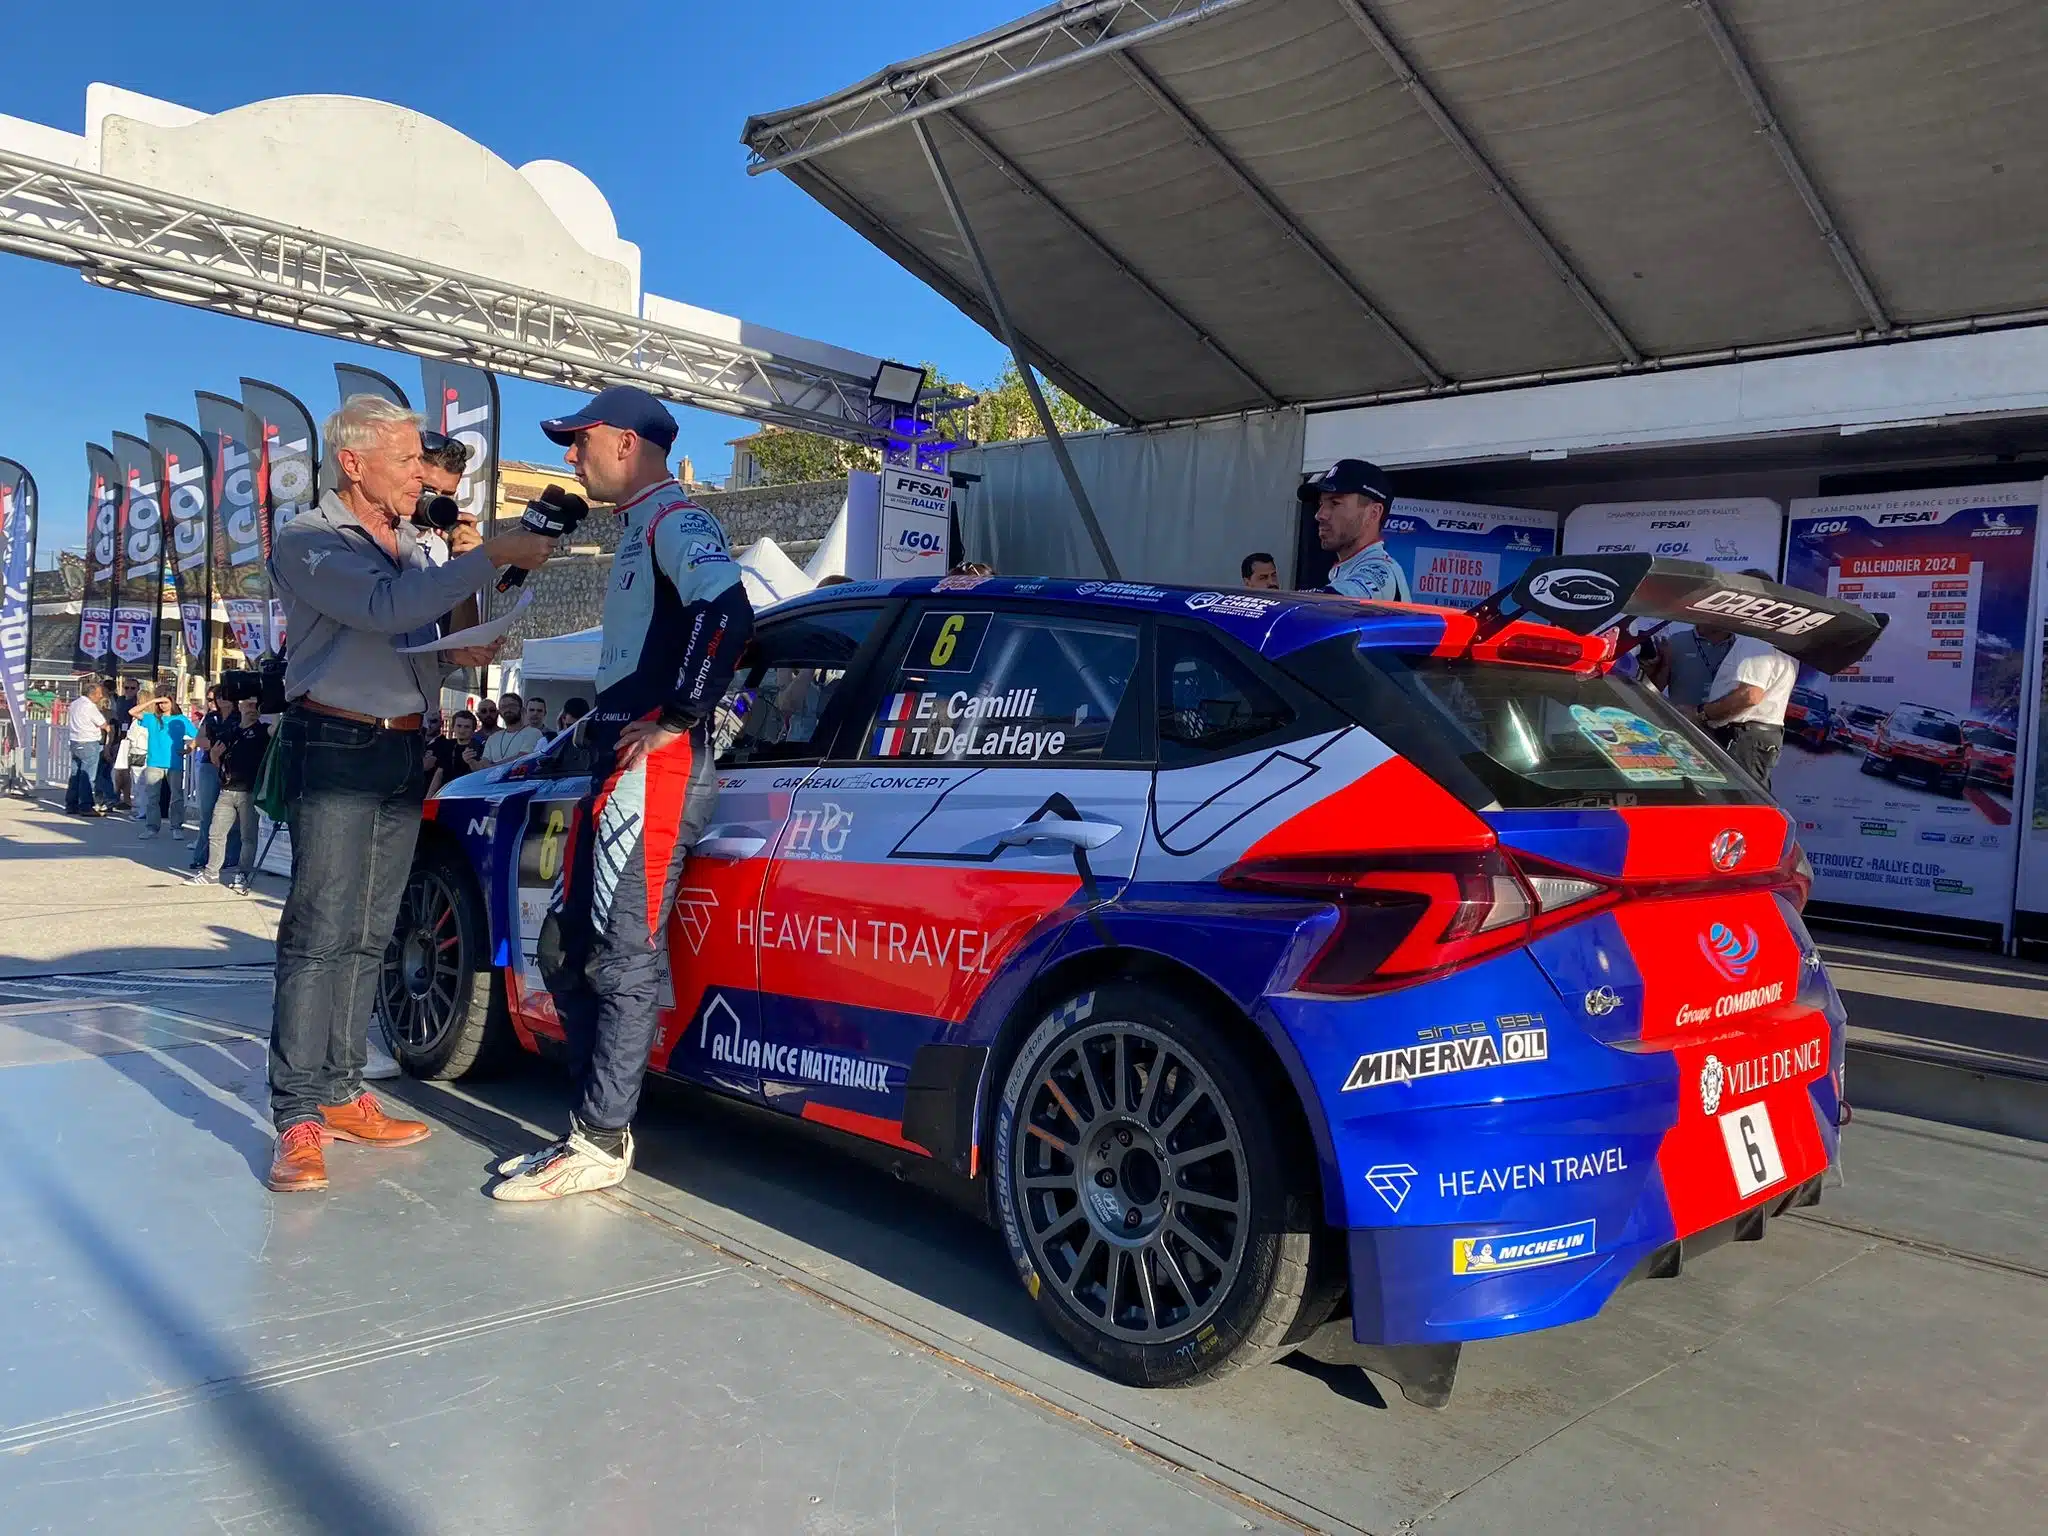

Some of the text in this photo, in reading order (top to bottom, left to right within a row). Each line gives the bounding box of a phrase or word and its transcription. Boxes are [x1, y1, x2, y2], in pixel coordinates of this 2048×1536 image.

[911, 498, 945, 512] RALLYE
[1810, 503, 1881, 514] CHAMPIONNAT
[1903, 500, 1943, 509] FRANCE
[1948, 497, 1968, 505] DES
[1971, 528, 2024, 537] MICHELIN
[1432, 557, 1483, 576] ANTIBES
[1854, 558, 1956, 574] CALENDRIER 2024
[1420, 573, 1492, 597] CÔTE D'AZUR
[929, 614, 965, 667] 6
[915, 688, 1037, 719] E. Camilli
[910, 727, 1066, 760] T. DeLaHaye
[772, 777, 950, 789] CARREAU CONCEPT
[540, 809, 564, 880] 6
[1807, 852, 1863, 869] RETROUVEZ
[1854, 872, 1884, 883] CHAQUE
[1885, 875, 1913, 886] RALLYE
[1915, 877, 1931, 888] SUR
[737, 909, 991, 974] HEAVEN TRAVEL
[1675, 981, 1784, 1028] Groupe COMBRONDE
[1417, 1014, 1546, 1041] since 1934
[712, 1033, 798, 1076] ALLIANCE
[799, 1049, 890, 1094] MATERIAUX
[1008, 1029, 1048, 1096] PILOT SPORT
[1346, 1031, 1545, 1086] MINERVA OIL
[1725, 1038, 1821, 1096] VILLE DE NICE
[1739, 1113, 1768, 1184] 6
[996, 1113, 1020, 1248] MICHELIN
[1439, 1147, 1628, 1198] HEAVEN TRAVEL
[1498, 1233, 1585, 1260] MICHELIN
